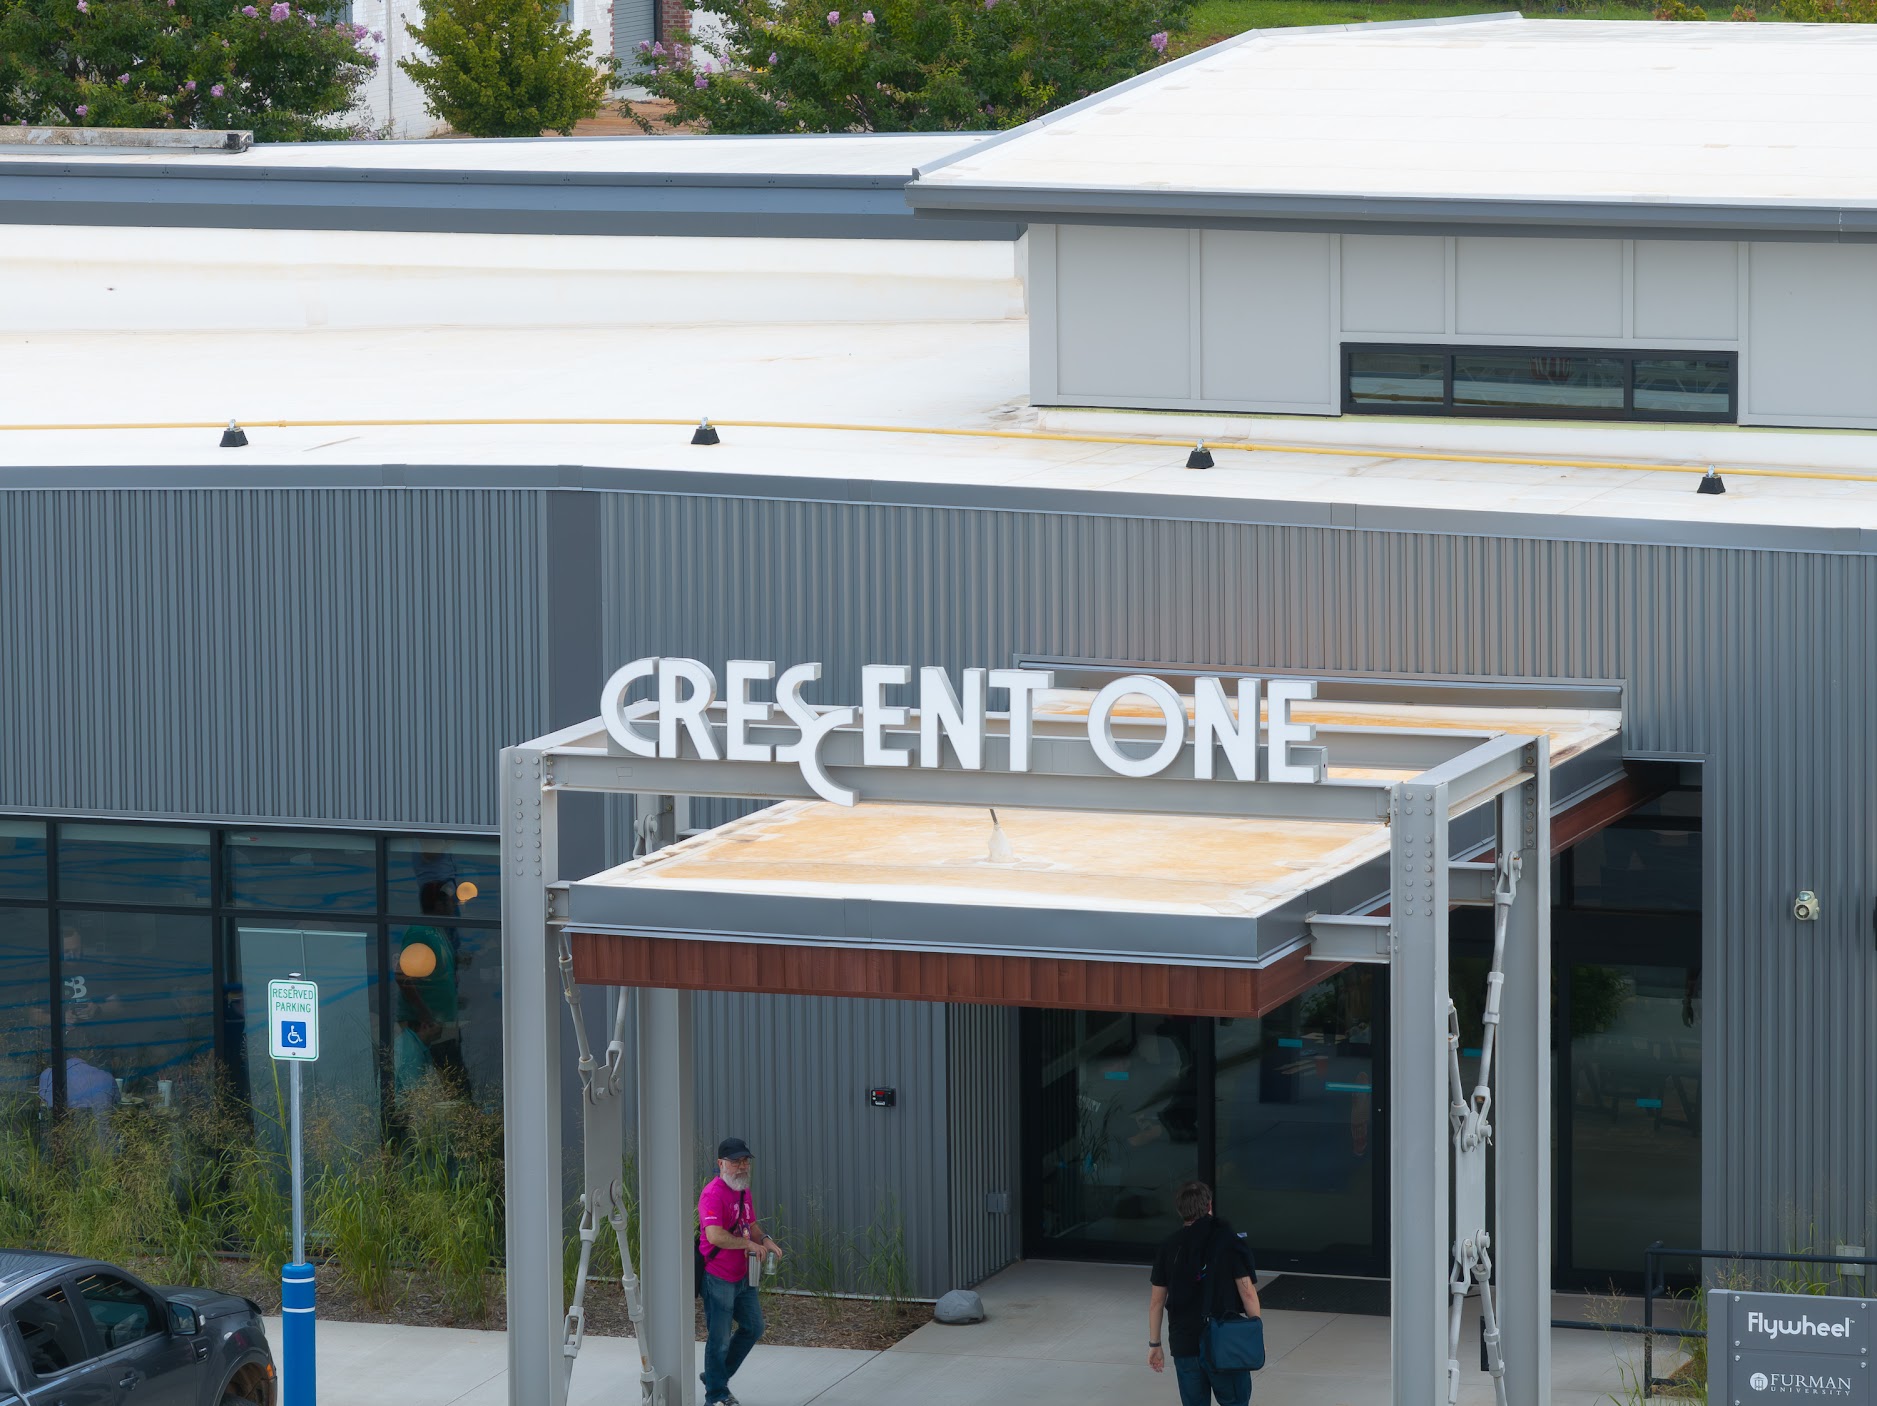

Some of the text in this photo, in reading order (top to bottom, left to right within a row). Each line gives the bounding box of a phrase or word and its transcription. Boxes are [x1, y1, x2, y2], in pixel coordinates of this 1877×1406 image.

[601, 656, 1318, 807] CRESCENT ONE
[272, 988, 314, 1000] RESERVED
[275, 1001, 312, 1013] PARKING
[1748, 1311, 1850, 1340] Flywheel
[1770, 1373, 1852, 1390] FURMAN
[1770, 1386, 1851, 1396] UNIVERSITY
